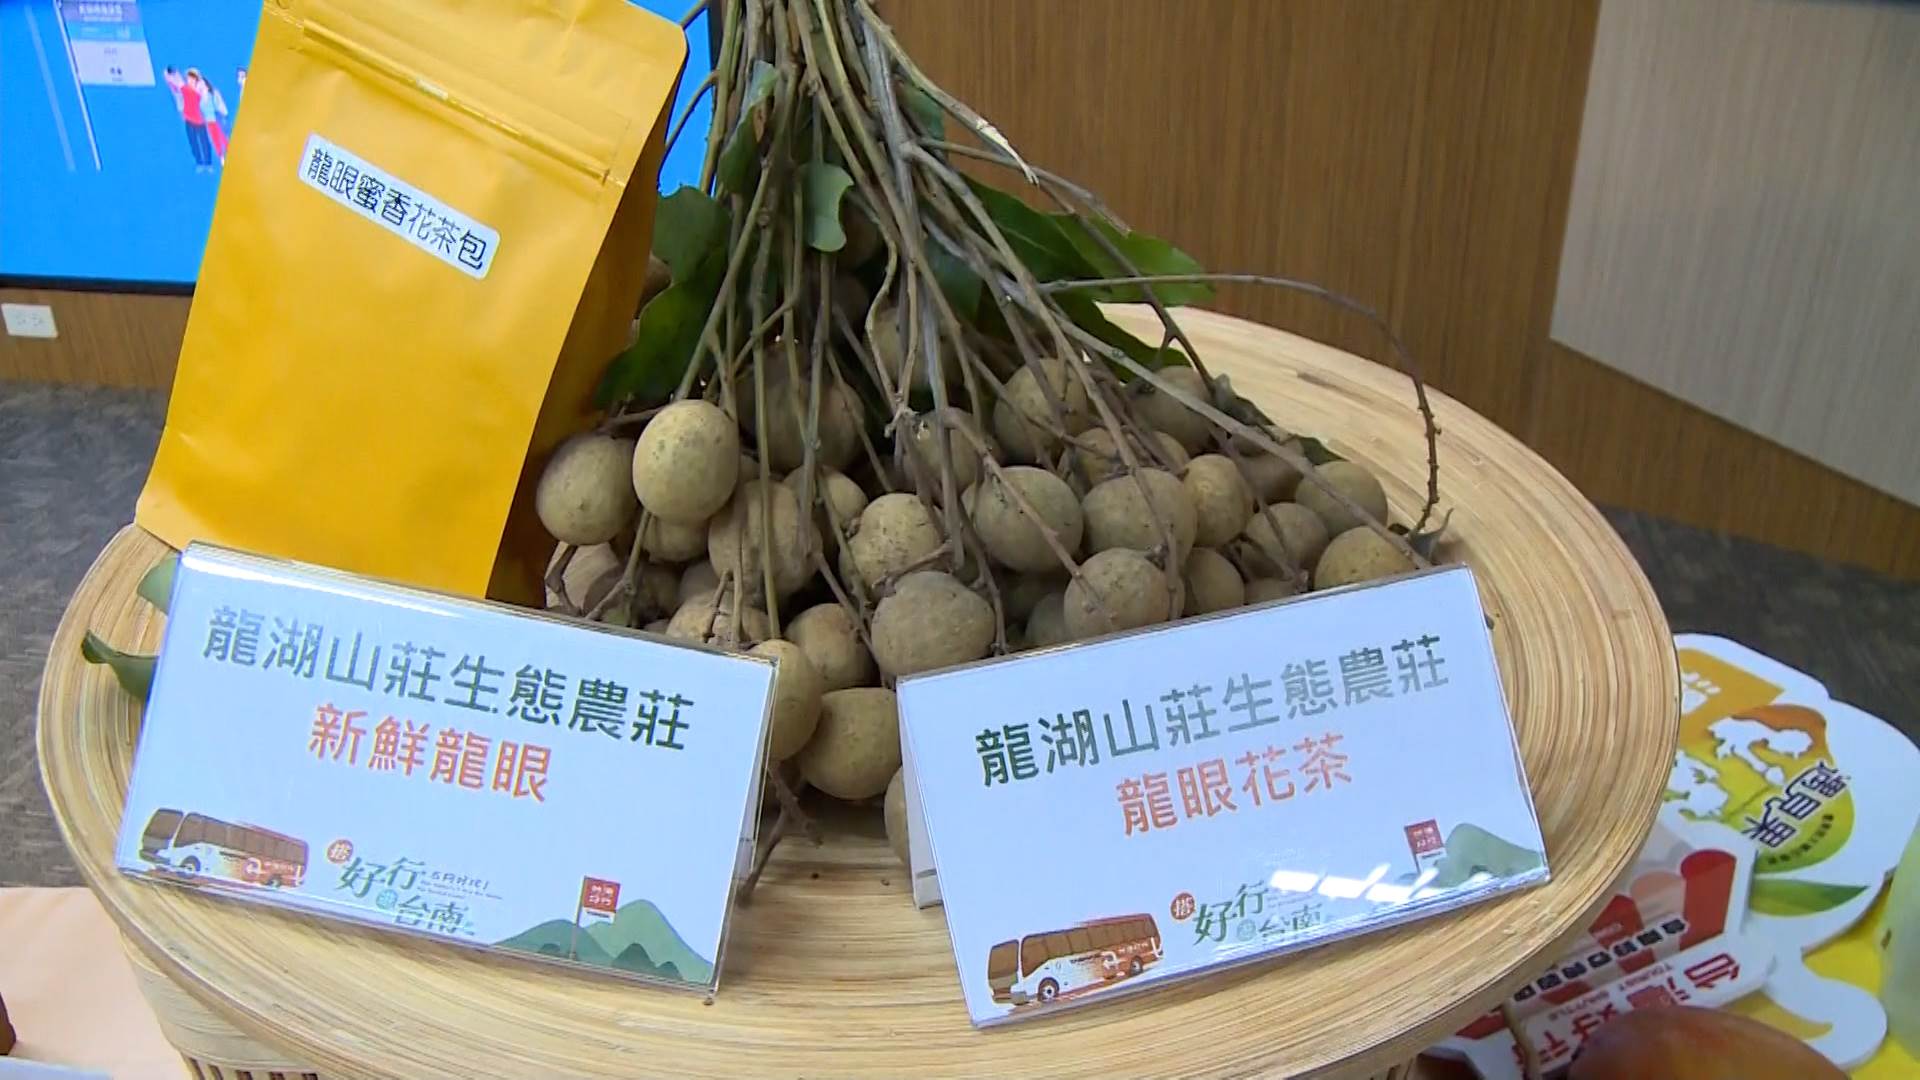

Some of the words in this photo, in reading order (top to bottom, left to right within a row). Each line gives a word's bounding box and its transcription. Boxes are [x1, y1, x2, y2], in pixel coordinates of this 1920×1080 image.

[306, 147, 487, 271] 龍眼蜜香花茶包
[203, 604, 695, 751] 龍湖山莊生態農莊
[974, 634, 1450, 788] 龍湖山莊生態農莊
[307, 701, 552, 802] 新鮮龍眼
[1115, 731, 1353, 836] 龍眼花茶
[1741, 761, 1850, 848] 遇見果
[336, 857, 426, 898] 好行
[1193, 880, 1268, 945] 好行
